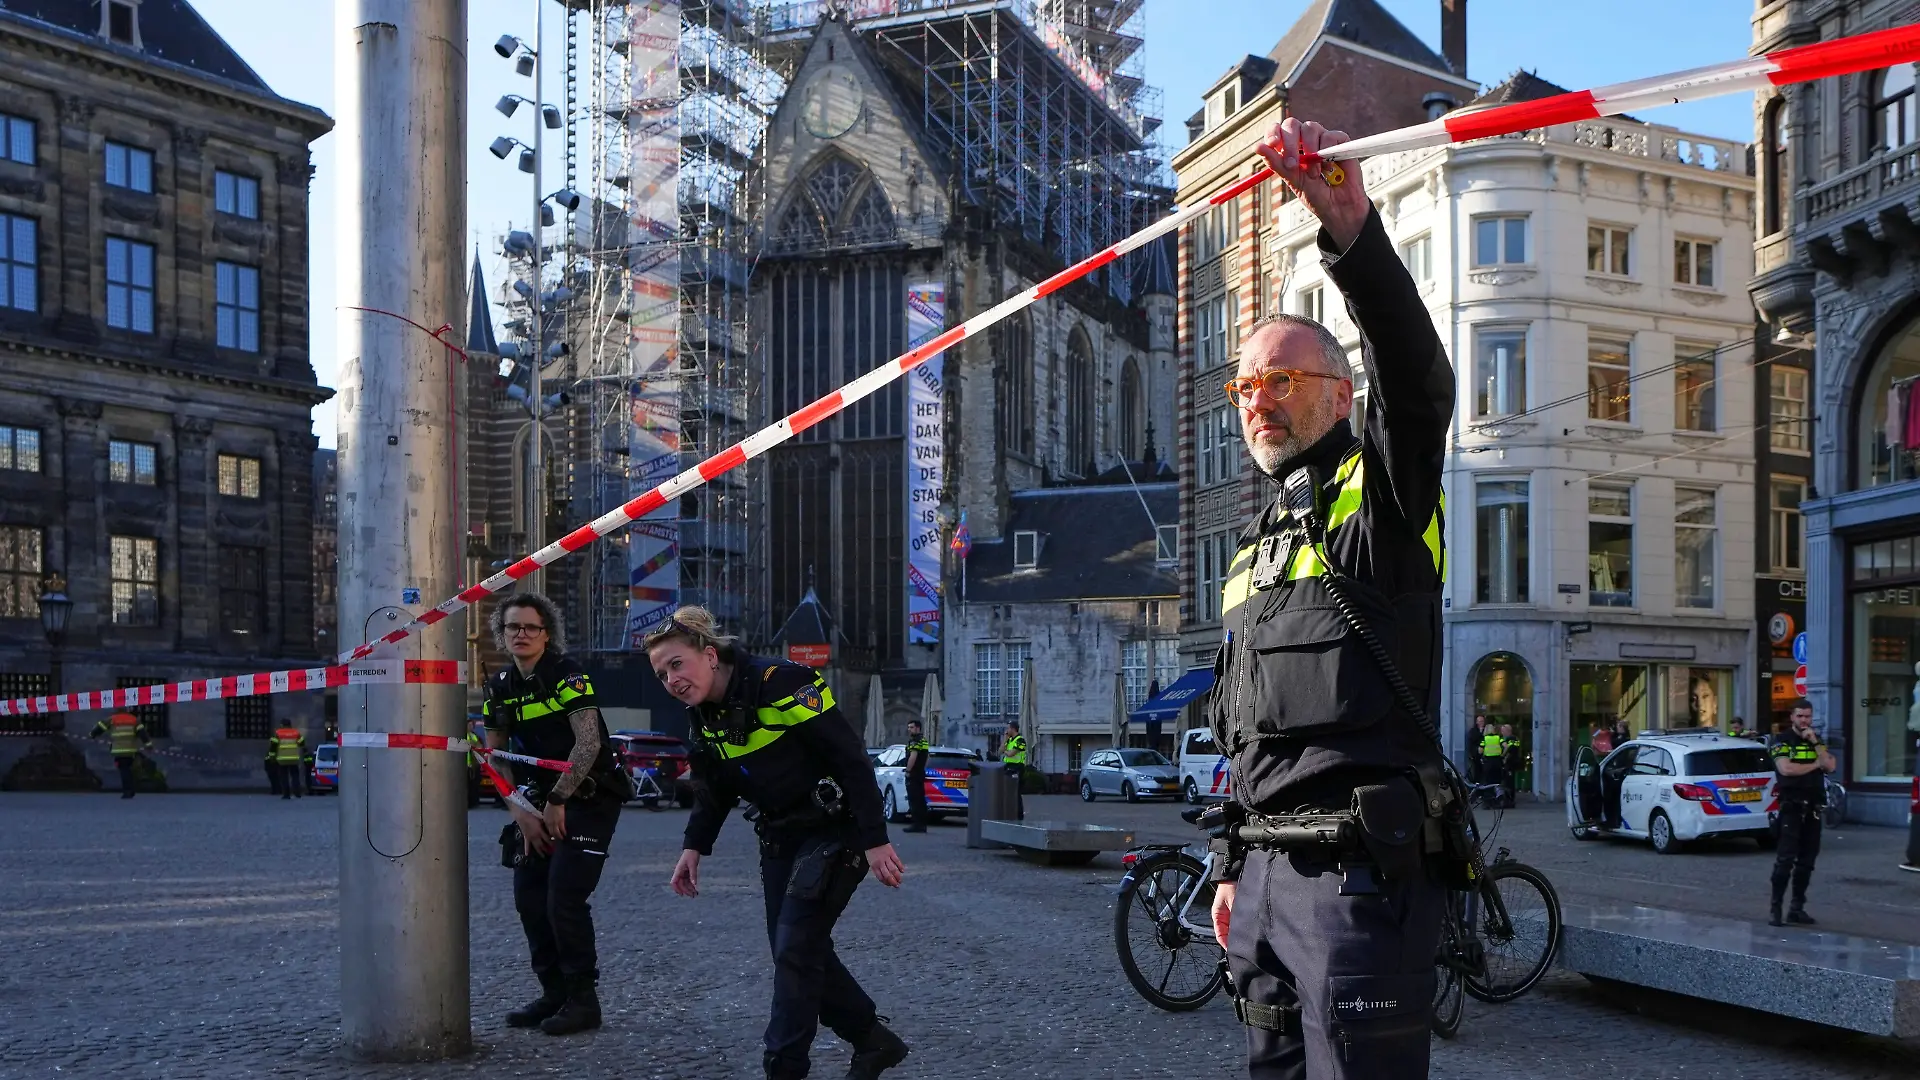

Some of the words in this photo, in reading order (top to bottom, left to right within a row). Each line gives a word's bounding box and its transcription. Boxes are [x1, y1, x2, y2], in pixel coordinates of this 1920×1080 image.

[914, 363, 943, 398] OERA
[917, 403, 940, 416] HET
[916, 424, 940, 438] DAK
[916, 445, 940, 459] VAN
[921, 467, 936, 480] DE
[922, 510, 934, 523] IS
[912, 528, 940, 551] OPEN
[352, 668, 387, 676] BETREDEN
[1349, 996, 1390, 1011] POLITIE
